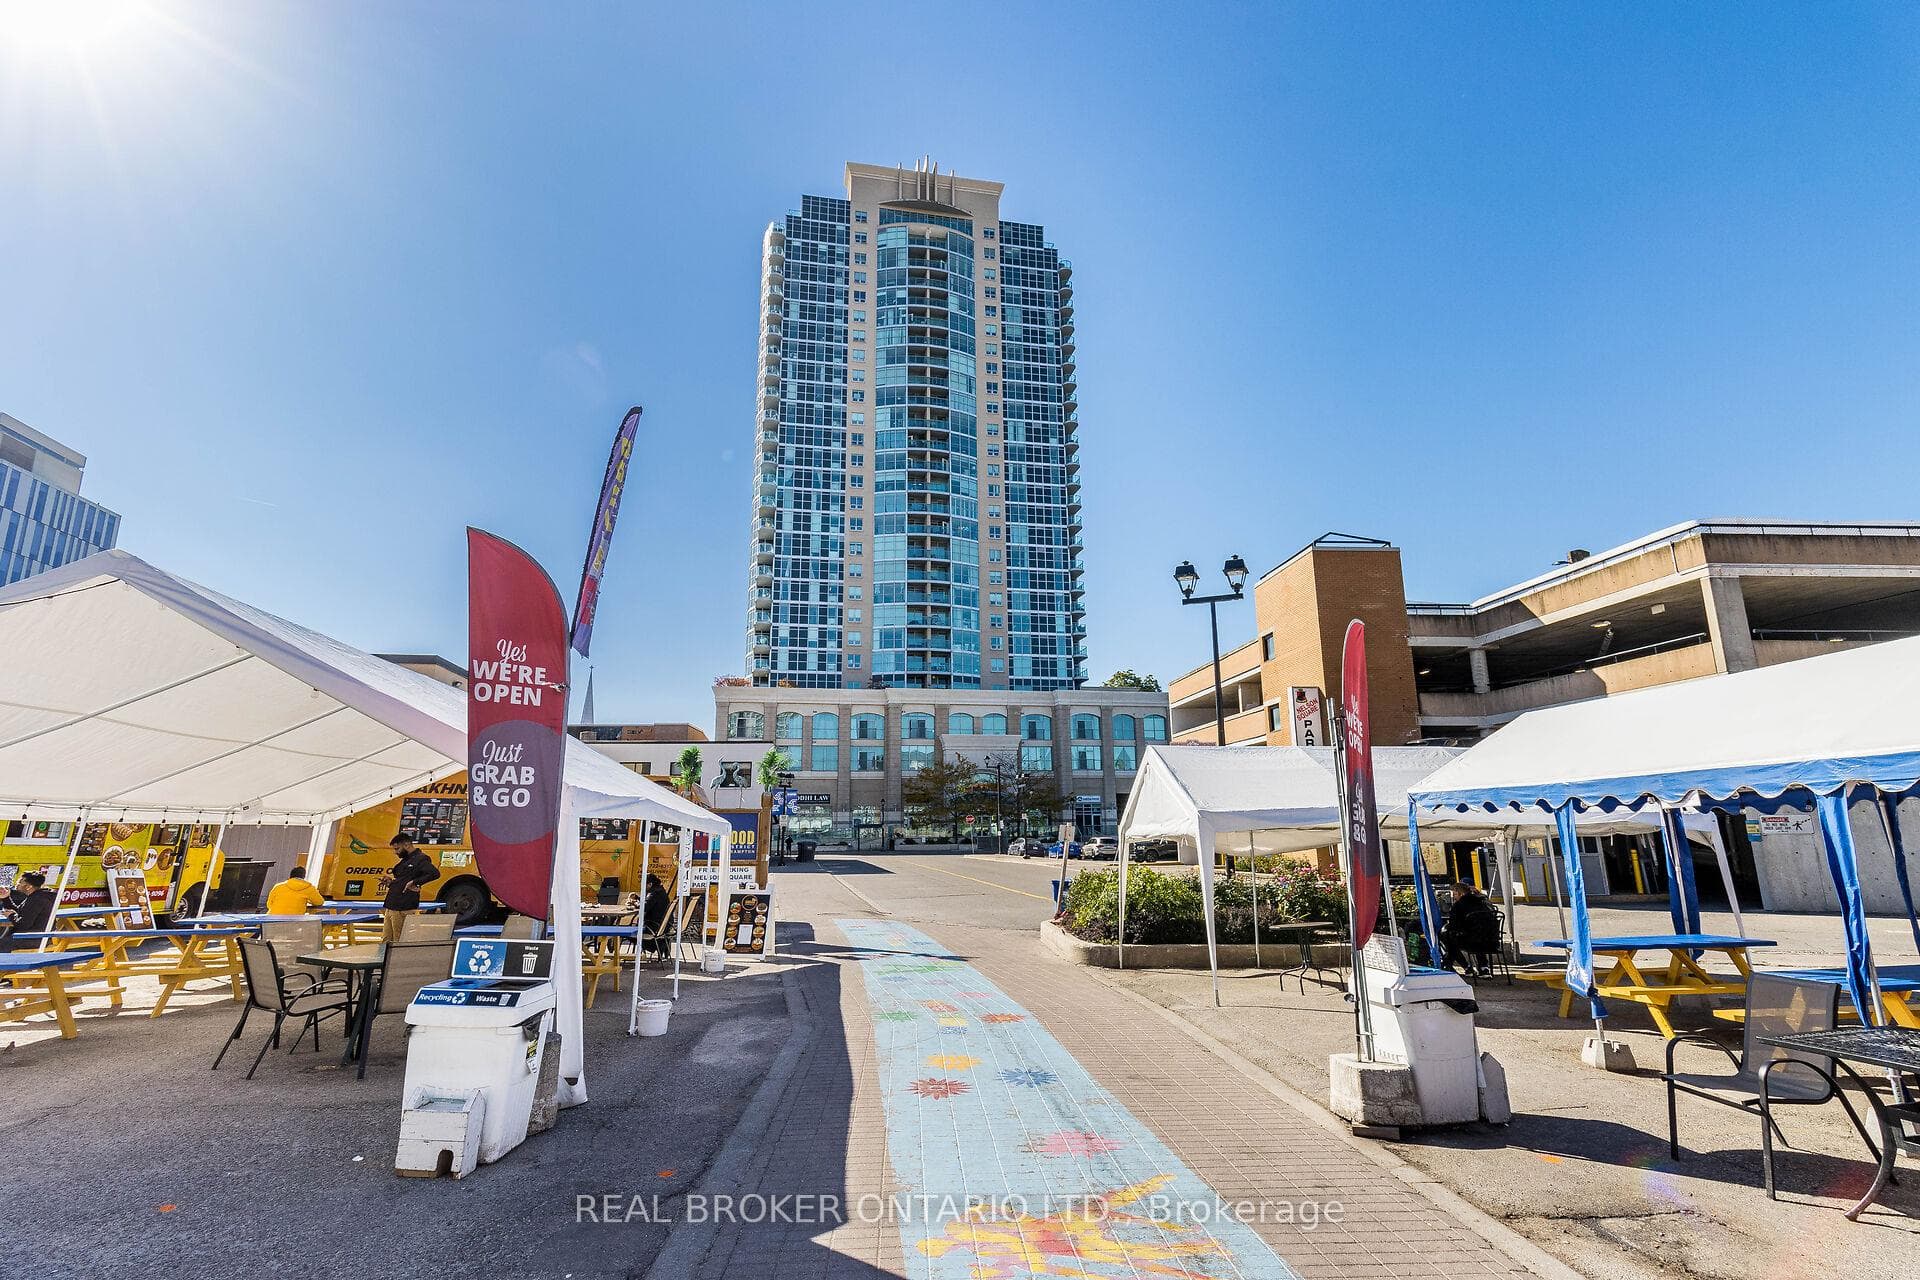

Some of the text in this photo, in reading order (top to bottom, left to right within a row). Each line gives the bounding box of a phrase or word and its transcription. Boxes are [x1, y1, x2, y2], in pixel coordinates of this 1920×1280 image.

[497, 639, 527, 664] Yes
[473, 660, 546, 686] WE'RE
[474, 683, 542, 707] OPEN
[1296, 698, 1319, 713] NELSON
[1296, 705, 1320, 721] SQUARE
[1304, 720, 1314, 746] PAR
[483, 740, 523, 765] Just
[472, 763, 535, 785] GRAB
[473, 786, 531, 808] & GO
[731, 831, 755, 845] OOD
[419, 993, 452, 1003] Recycling
[476, 994, 498, 1002] Waste
